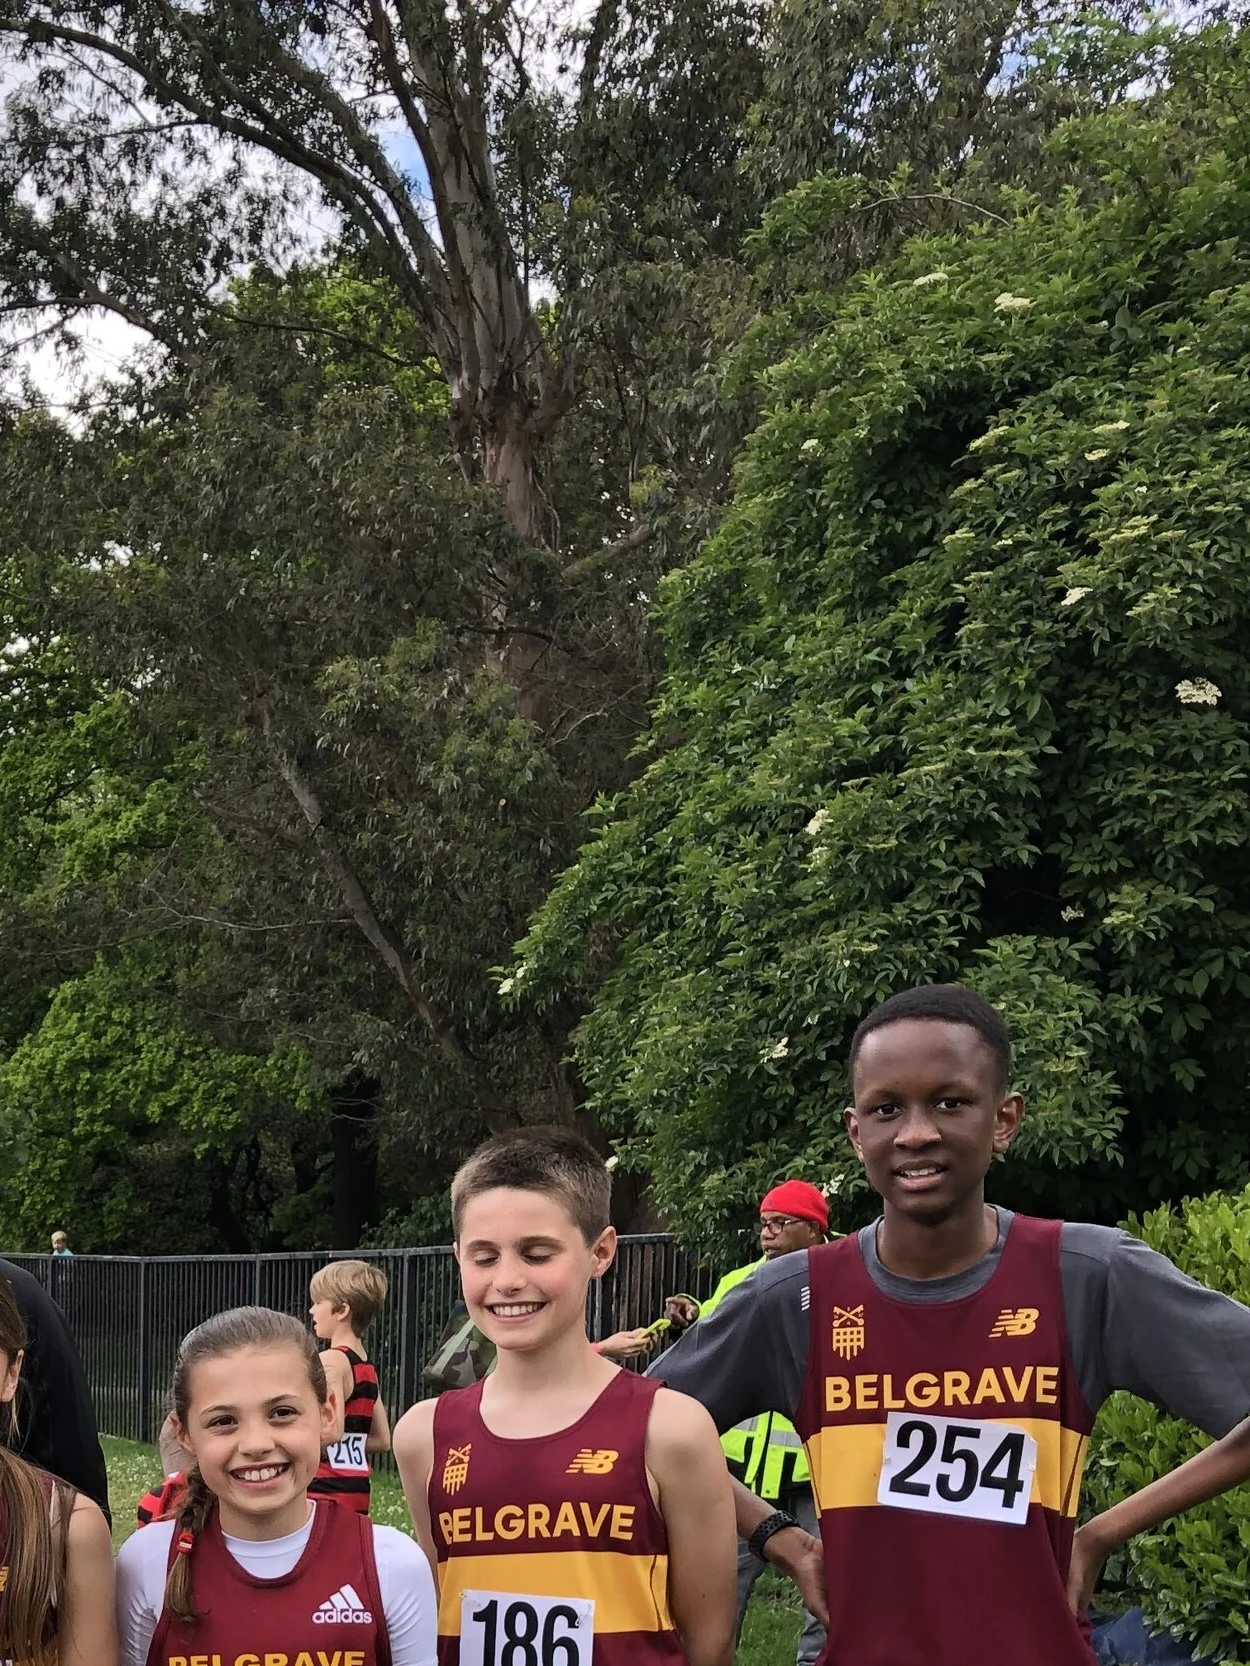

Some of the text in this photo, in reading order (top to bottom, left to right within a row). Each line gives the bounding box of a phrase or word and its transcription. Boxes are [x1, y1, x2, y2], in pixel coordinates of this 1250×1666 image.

[825, 1366, 1059, 1412] BELGRAVE
[333, 1436, 363, 1465] 215
[889, 1420, 1025, 1509] 254
[439, 1502, 636, 1545] BELGRAVE
[312, 1609, 373, 1624] adidas
